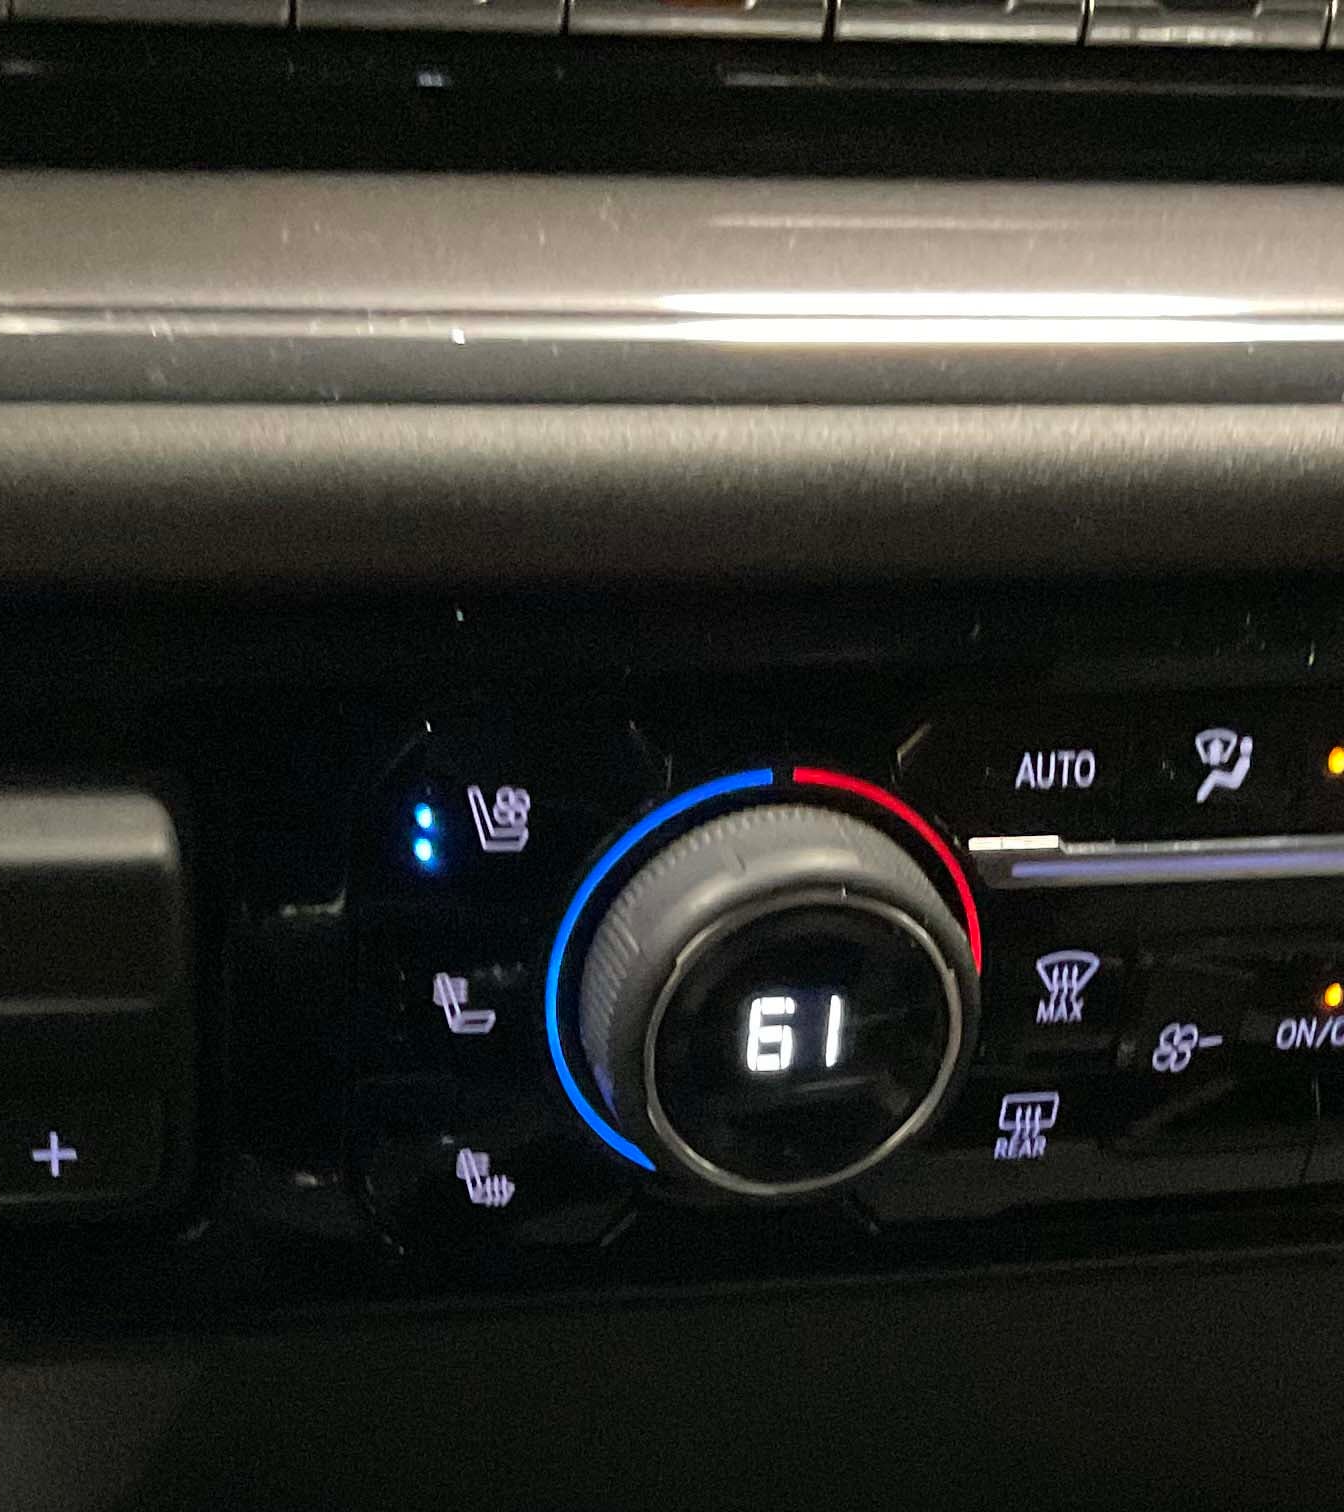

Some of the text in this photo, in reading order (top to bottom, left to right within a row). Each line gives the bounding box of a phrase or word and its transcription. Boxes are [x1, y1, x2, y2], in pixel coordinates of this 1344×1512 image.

[1015, 749, 1097, 791] AUTO
[1036, 998, 1085, 1025] MAX
[746, 994, 846, 1074] 61
[993, 1135, 1048, 1161] REAR
